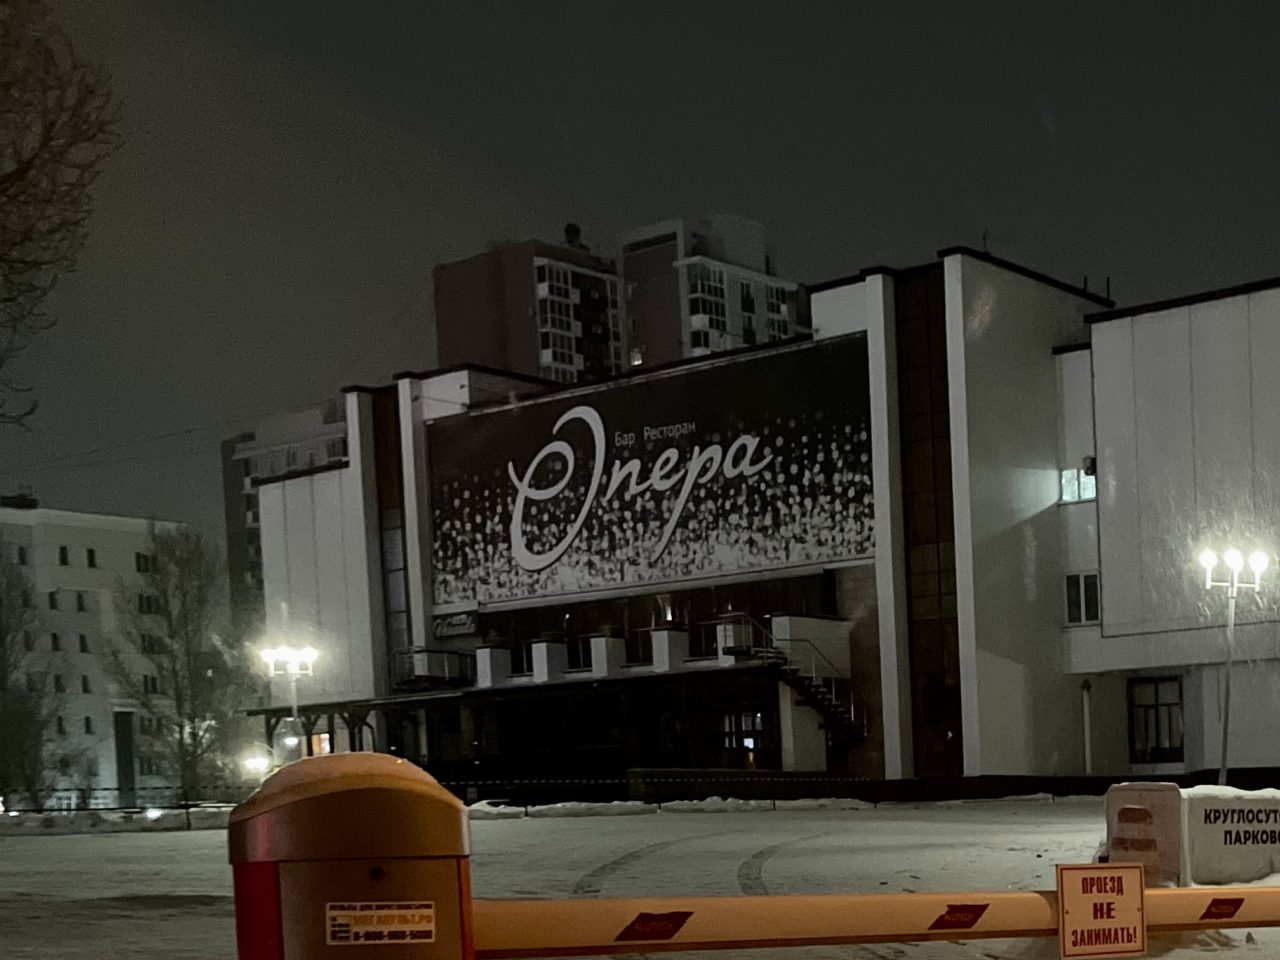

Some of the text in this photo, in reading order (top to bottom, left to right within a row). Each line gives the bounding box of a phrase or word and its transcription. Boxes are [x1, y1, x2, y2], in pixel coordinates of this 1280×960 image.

[614, 421, 696, 448] Бар Ресторан
[508, 405, 774, 572] Опера
[1081, 876, 1124, 896] ПРОЕЗД
[1092, 902, 1116, 920] НЕ
[1071, 926, 1137, 947] ЗАНИМАТЬ!
